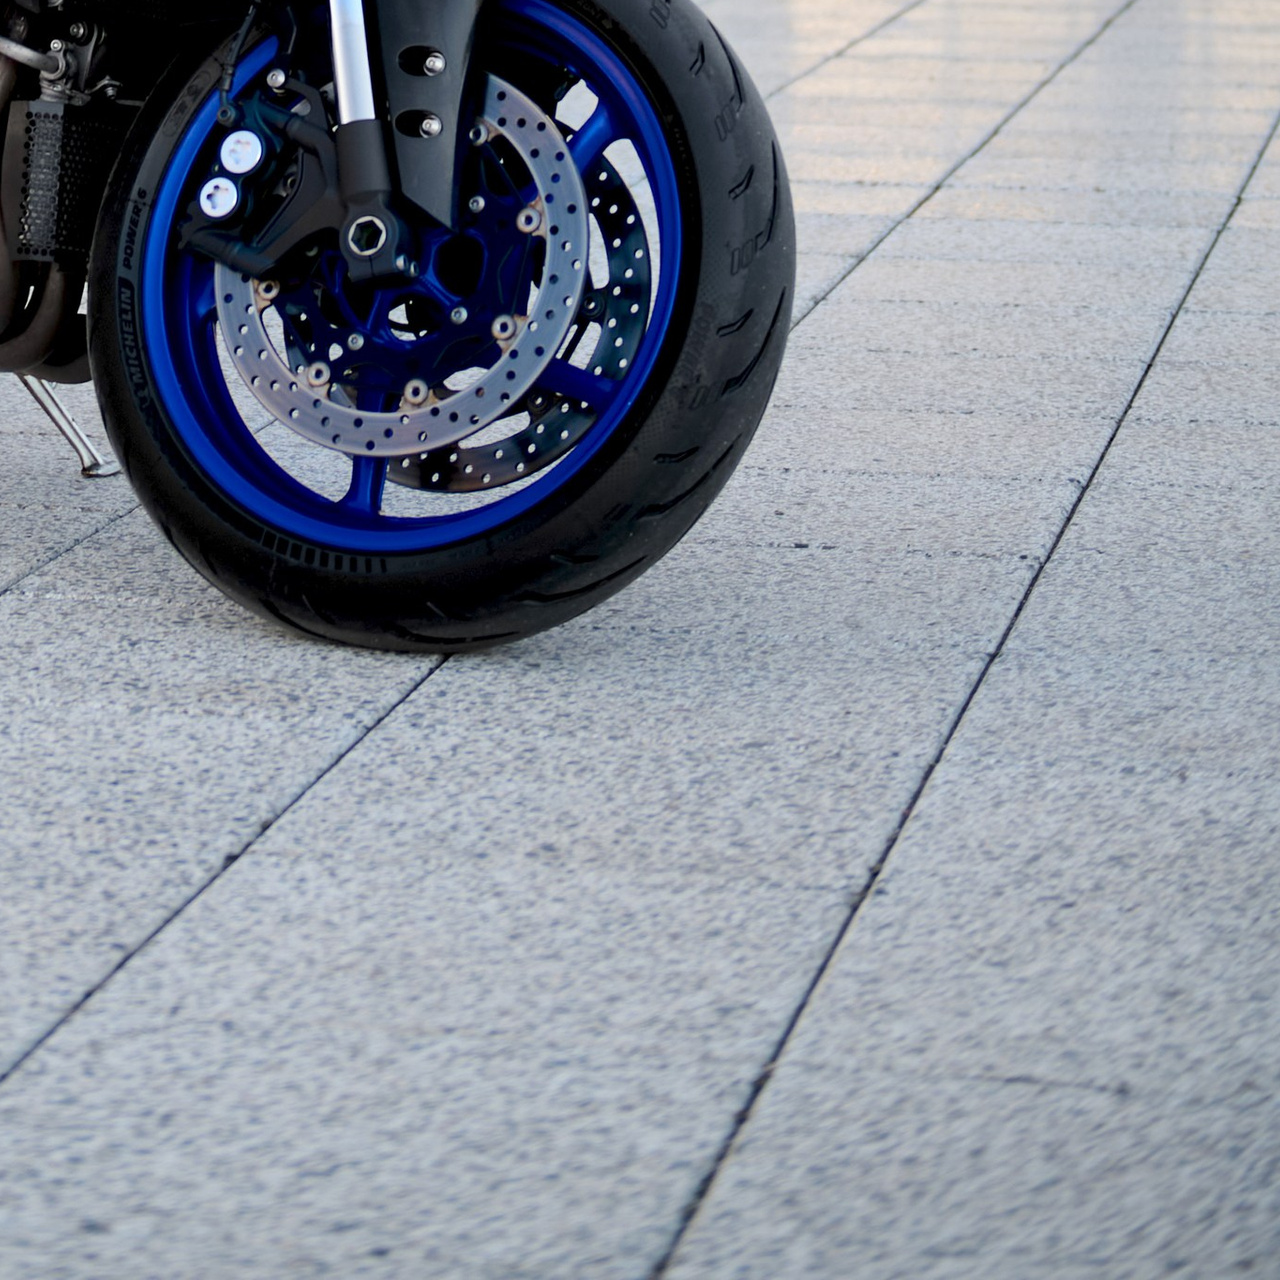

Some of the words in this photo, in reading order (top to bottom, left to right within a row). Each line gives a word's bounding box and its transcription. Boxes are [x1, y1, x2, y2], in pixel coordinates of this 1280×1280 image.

[137, 187, 147, 200] 6
[122, 204, 143, 270] POWER
[119, 290, 146, 384] MICHELIN
